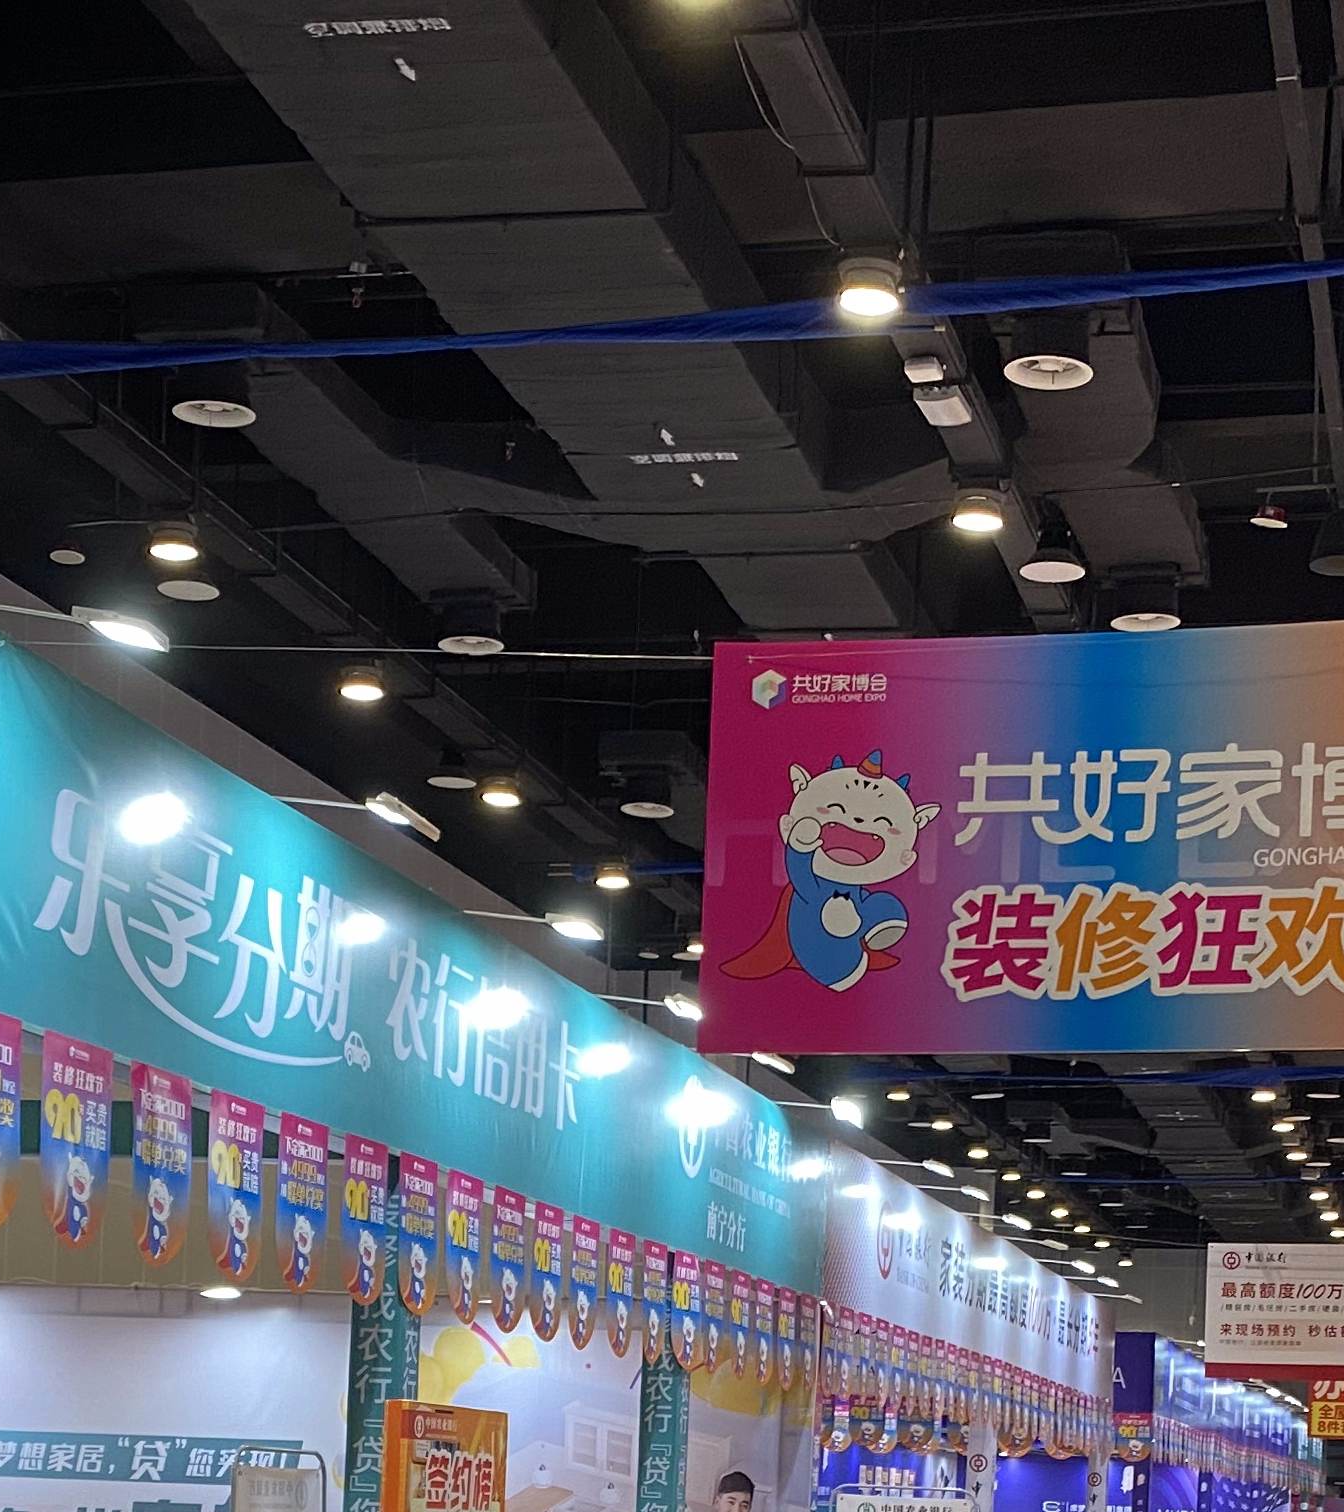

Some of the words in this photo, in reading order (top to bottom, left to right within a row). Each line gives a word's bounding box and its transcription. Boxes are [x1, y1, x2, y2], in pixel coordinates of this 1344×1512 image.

[792, 674, 888, 693] 共好家博会
[792, 694, 836, 704] GONGHAO
[837, 693, 863, 703] HOME
[864, 692, 887, 702] EXPO
[33, 788, 354, 1041] 乐享分期
[706, 1201, 747, 1252] 南宁分行
[1220, 1323, 1296, 1339] 来现场预约
